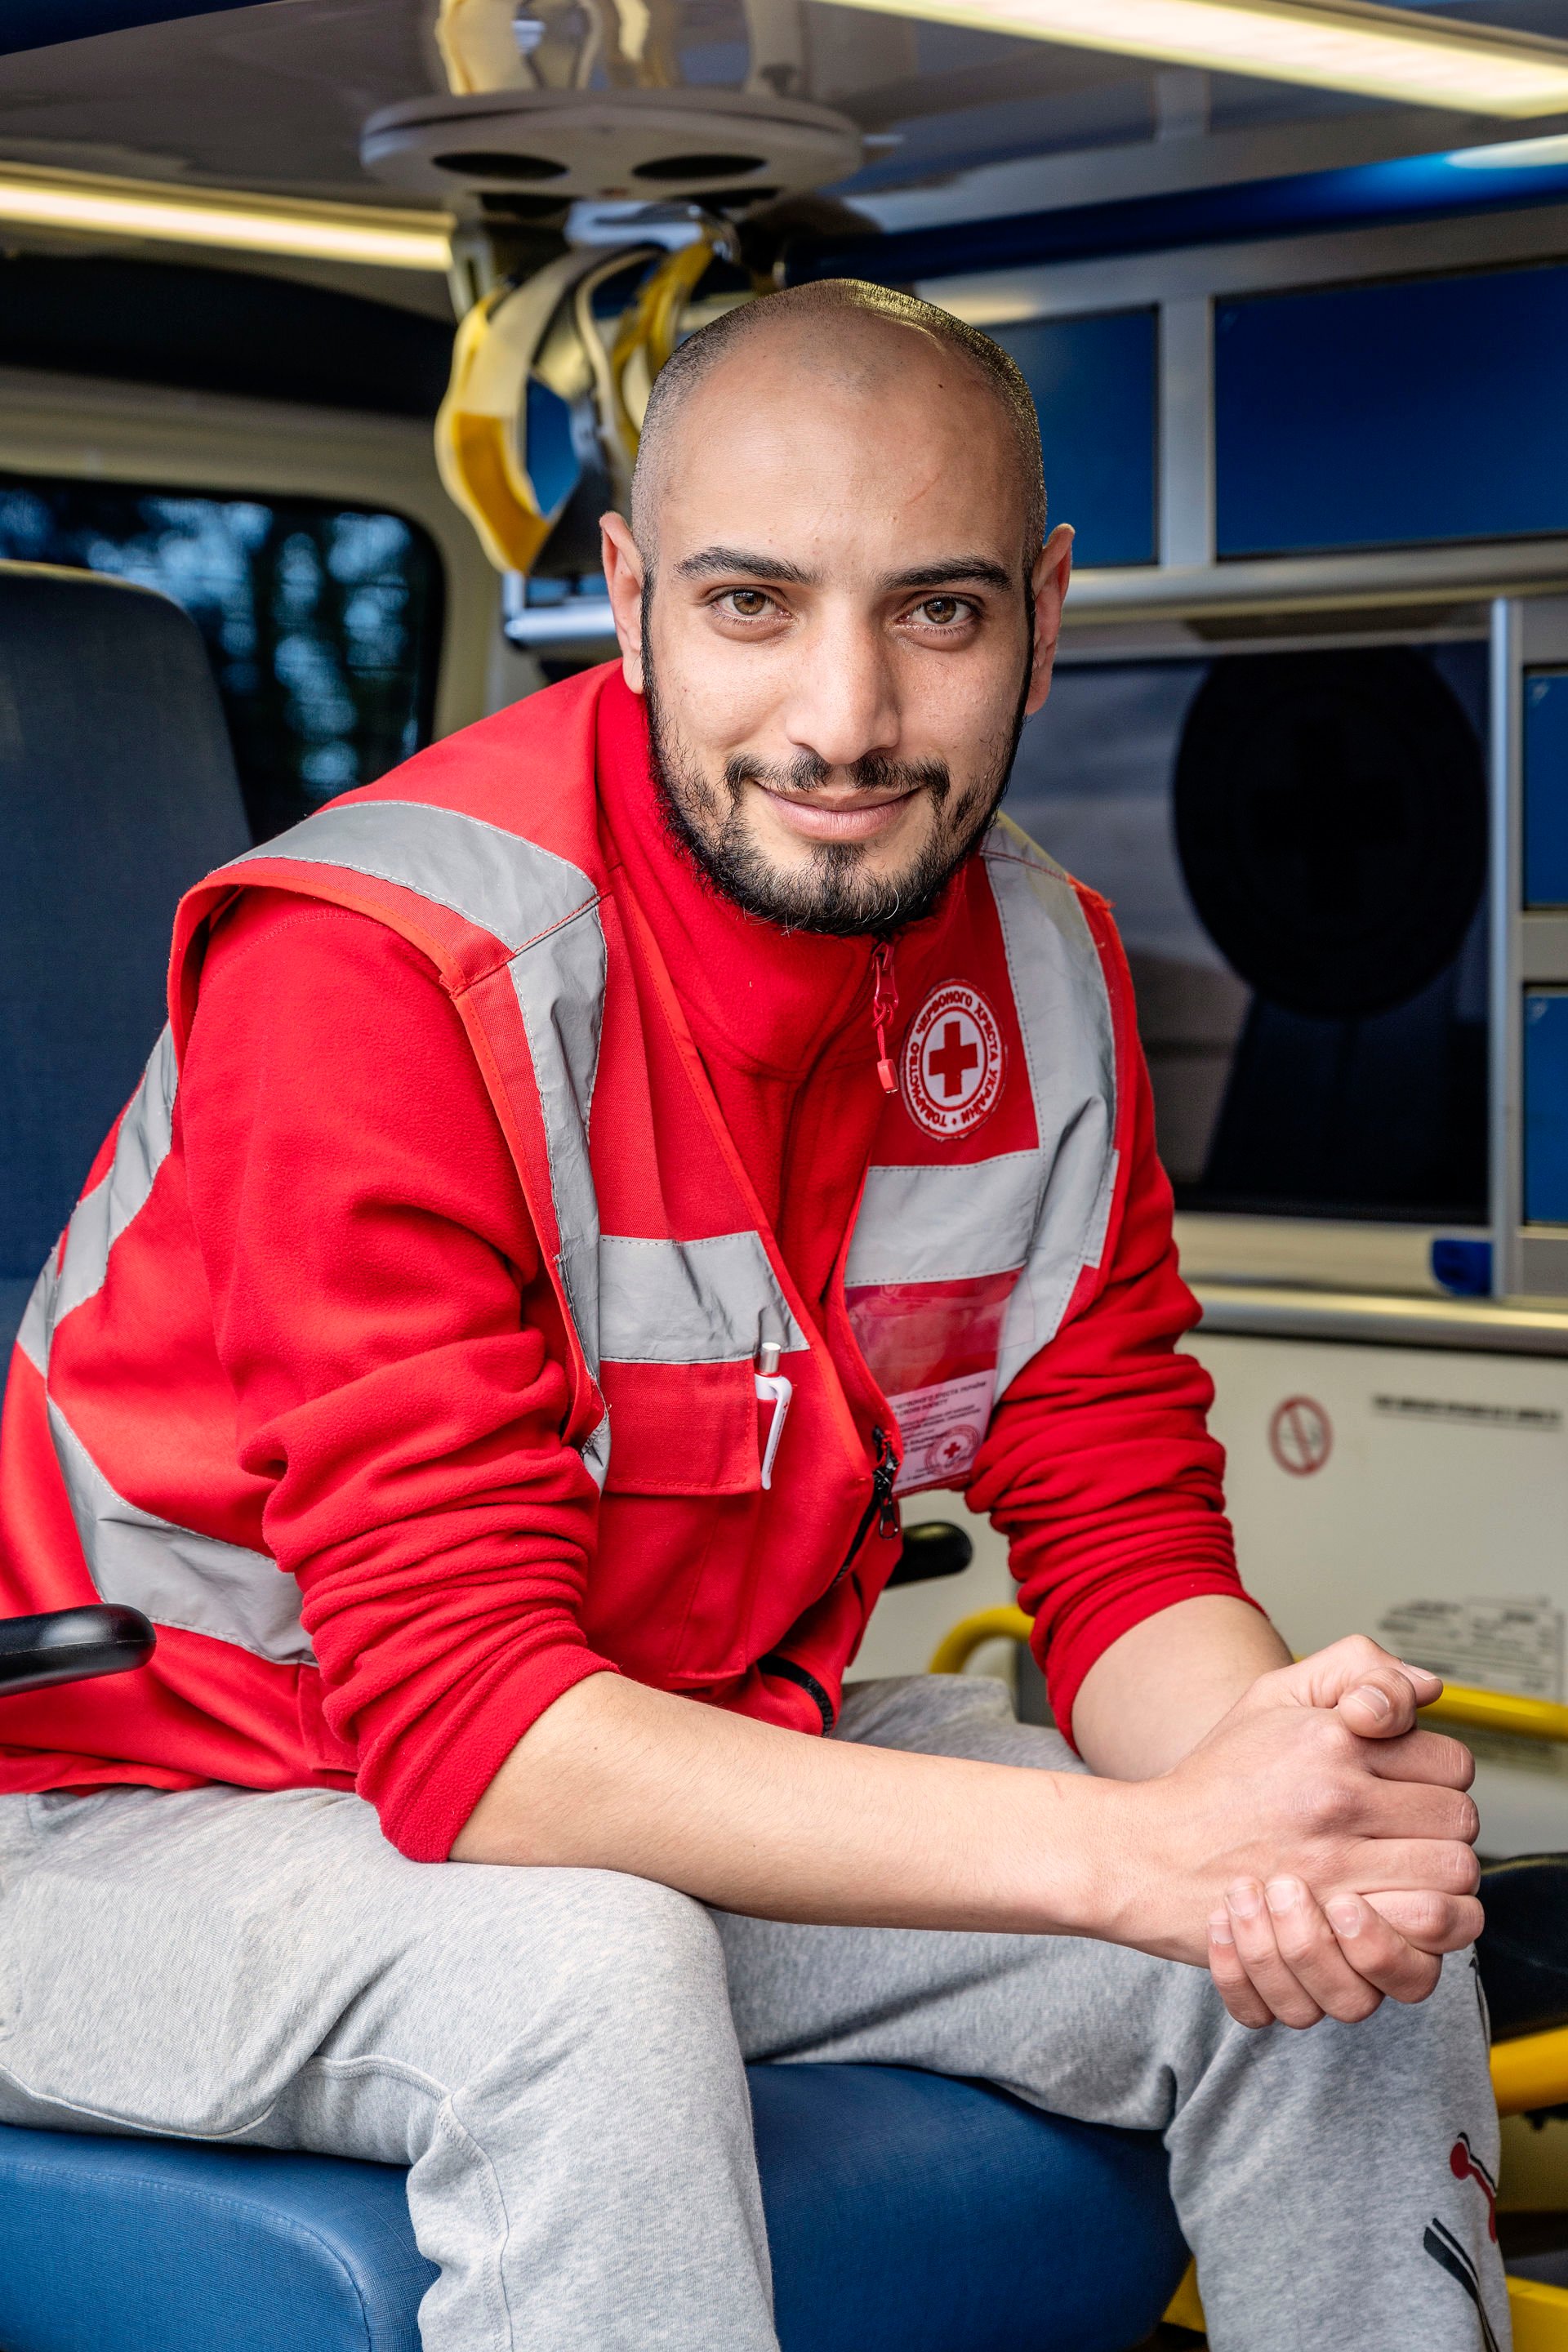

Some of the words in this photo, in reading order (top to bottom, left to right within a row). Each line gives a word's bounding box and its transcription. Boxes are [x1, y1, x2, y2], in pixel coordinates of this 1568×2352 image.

[916, 991, 972, 1034] ЧЕРВОНОГО
[974, 1002, 999, 1062] ХРЕСТА
[910, 1042, 947, 1127] ТОВАРИСТВО
[960, 1067, 998, 1124] УКРАЇНИ
